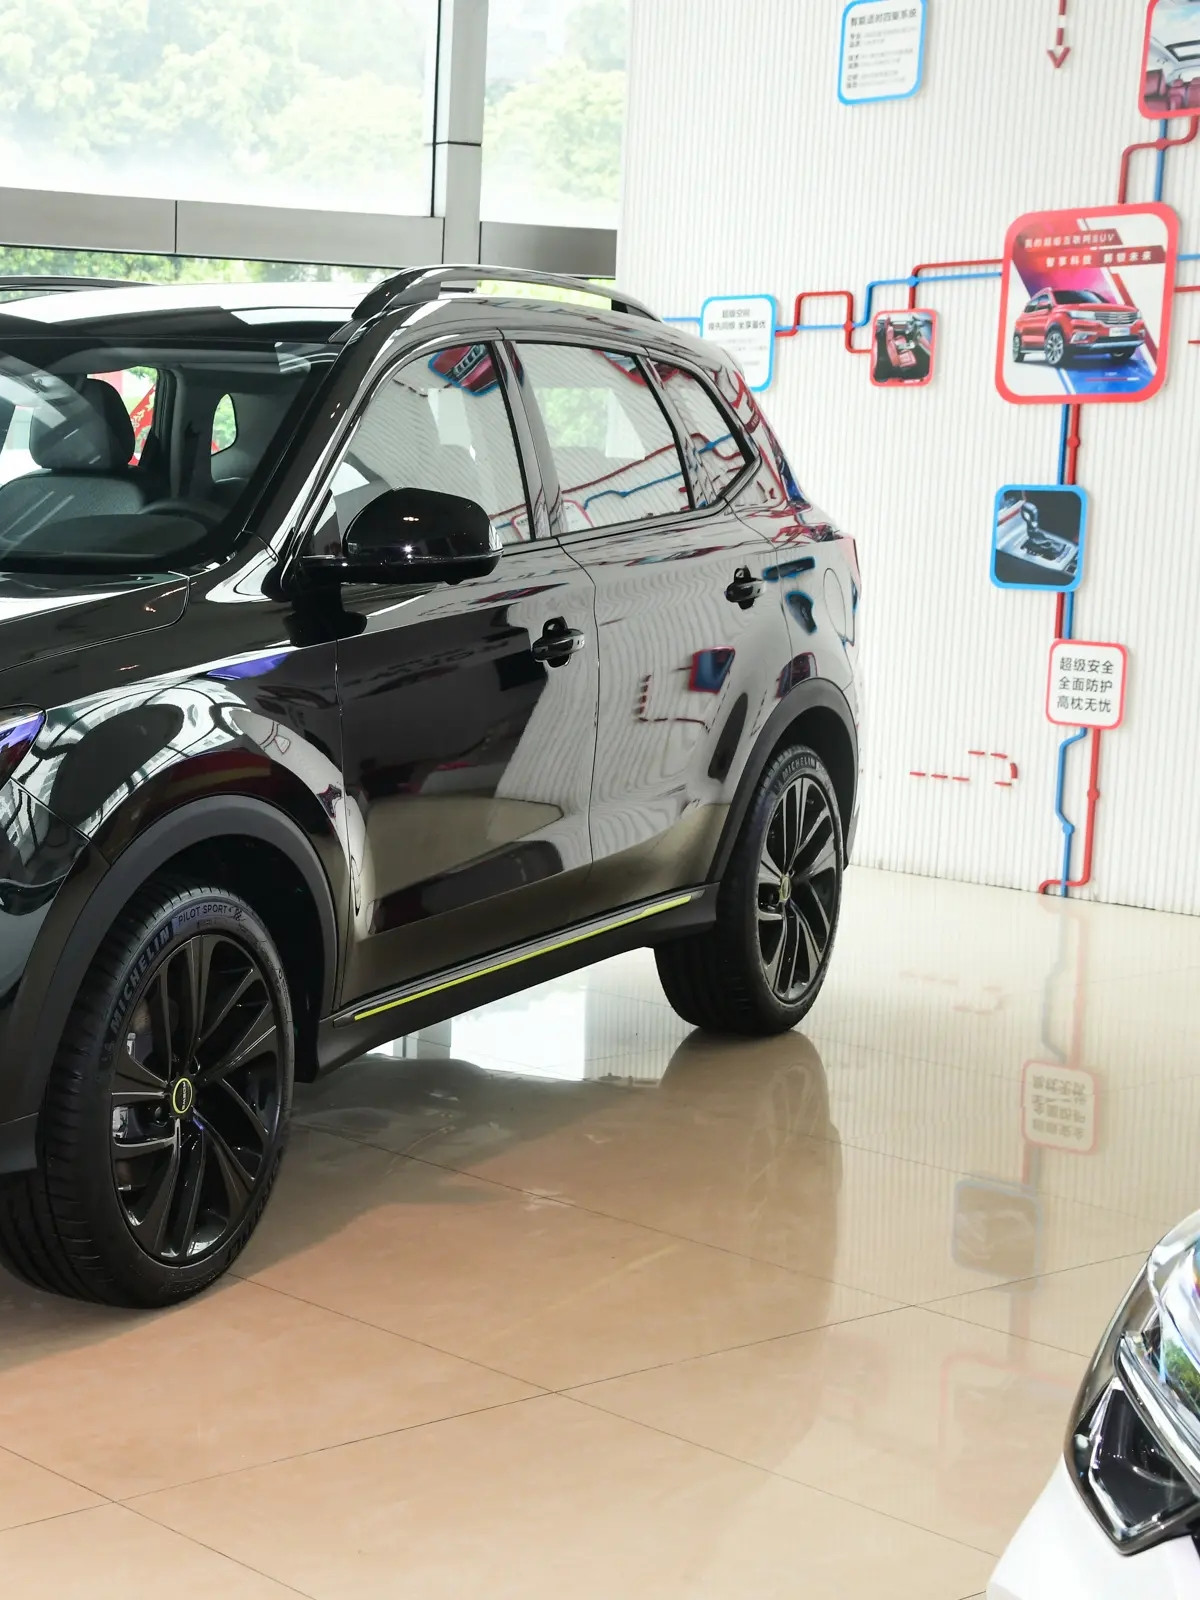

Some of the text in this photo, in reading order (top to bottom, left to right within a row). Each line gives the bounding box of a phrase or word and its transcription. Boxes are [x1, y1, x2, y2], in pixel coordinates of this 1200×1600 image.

[1059, 656, 1114, 674] 超级安全
[1058, 676, 1113, 693] 全面防护
[1057, 695, 1112, 713] 高枕无忧
[782, 756, 816, 781] MICHELIN
[177, 906, 201, 926] PILOT
[202, 904, 229, 915] SPORT
[109, 922, 172, 1035] MICHELIN
